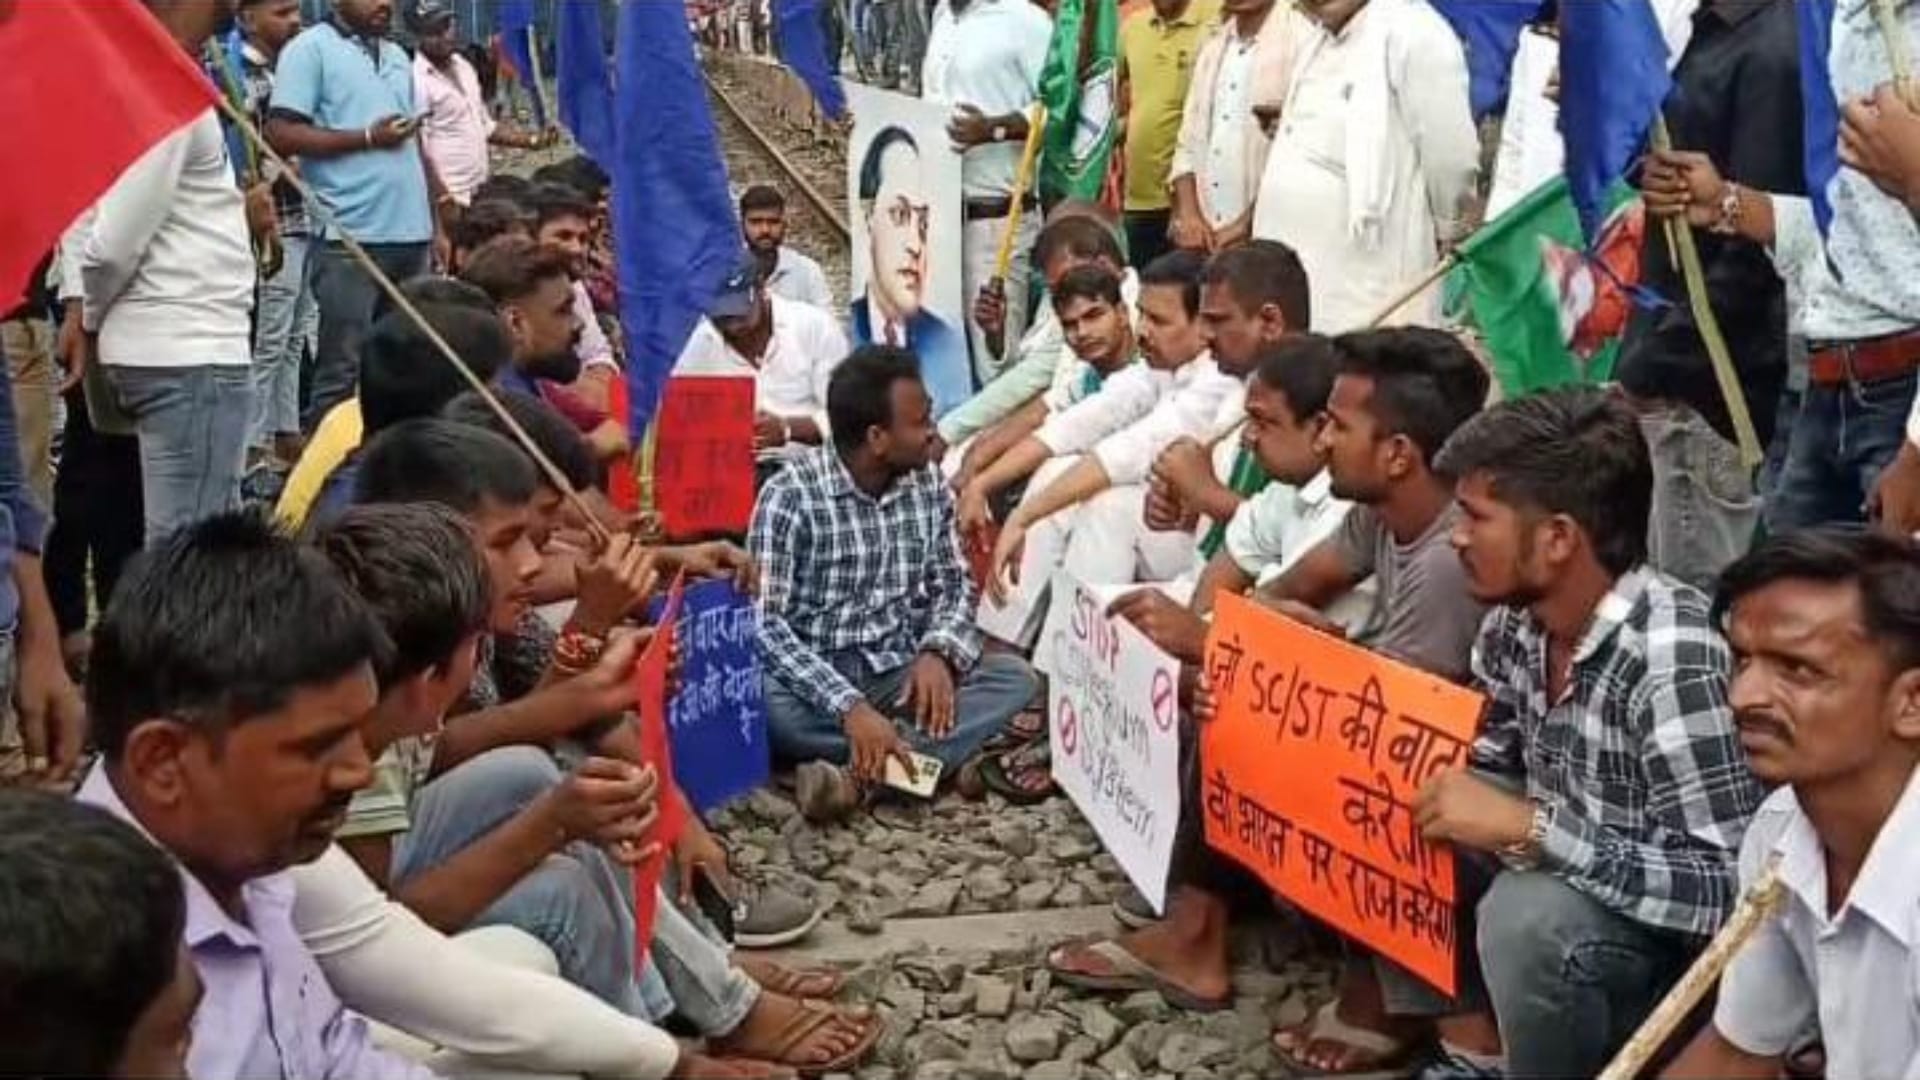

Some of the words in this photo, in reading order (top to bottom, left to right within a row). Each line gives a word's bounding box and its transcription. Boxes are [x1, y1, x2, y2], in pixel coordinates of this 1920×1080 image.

[1250, 661, 1339, 742] SC/ST
[1340, 675, 1388, 768] की
[1299, 829, 1339, 897] पर
